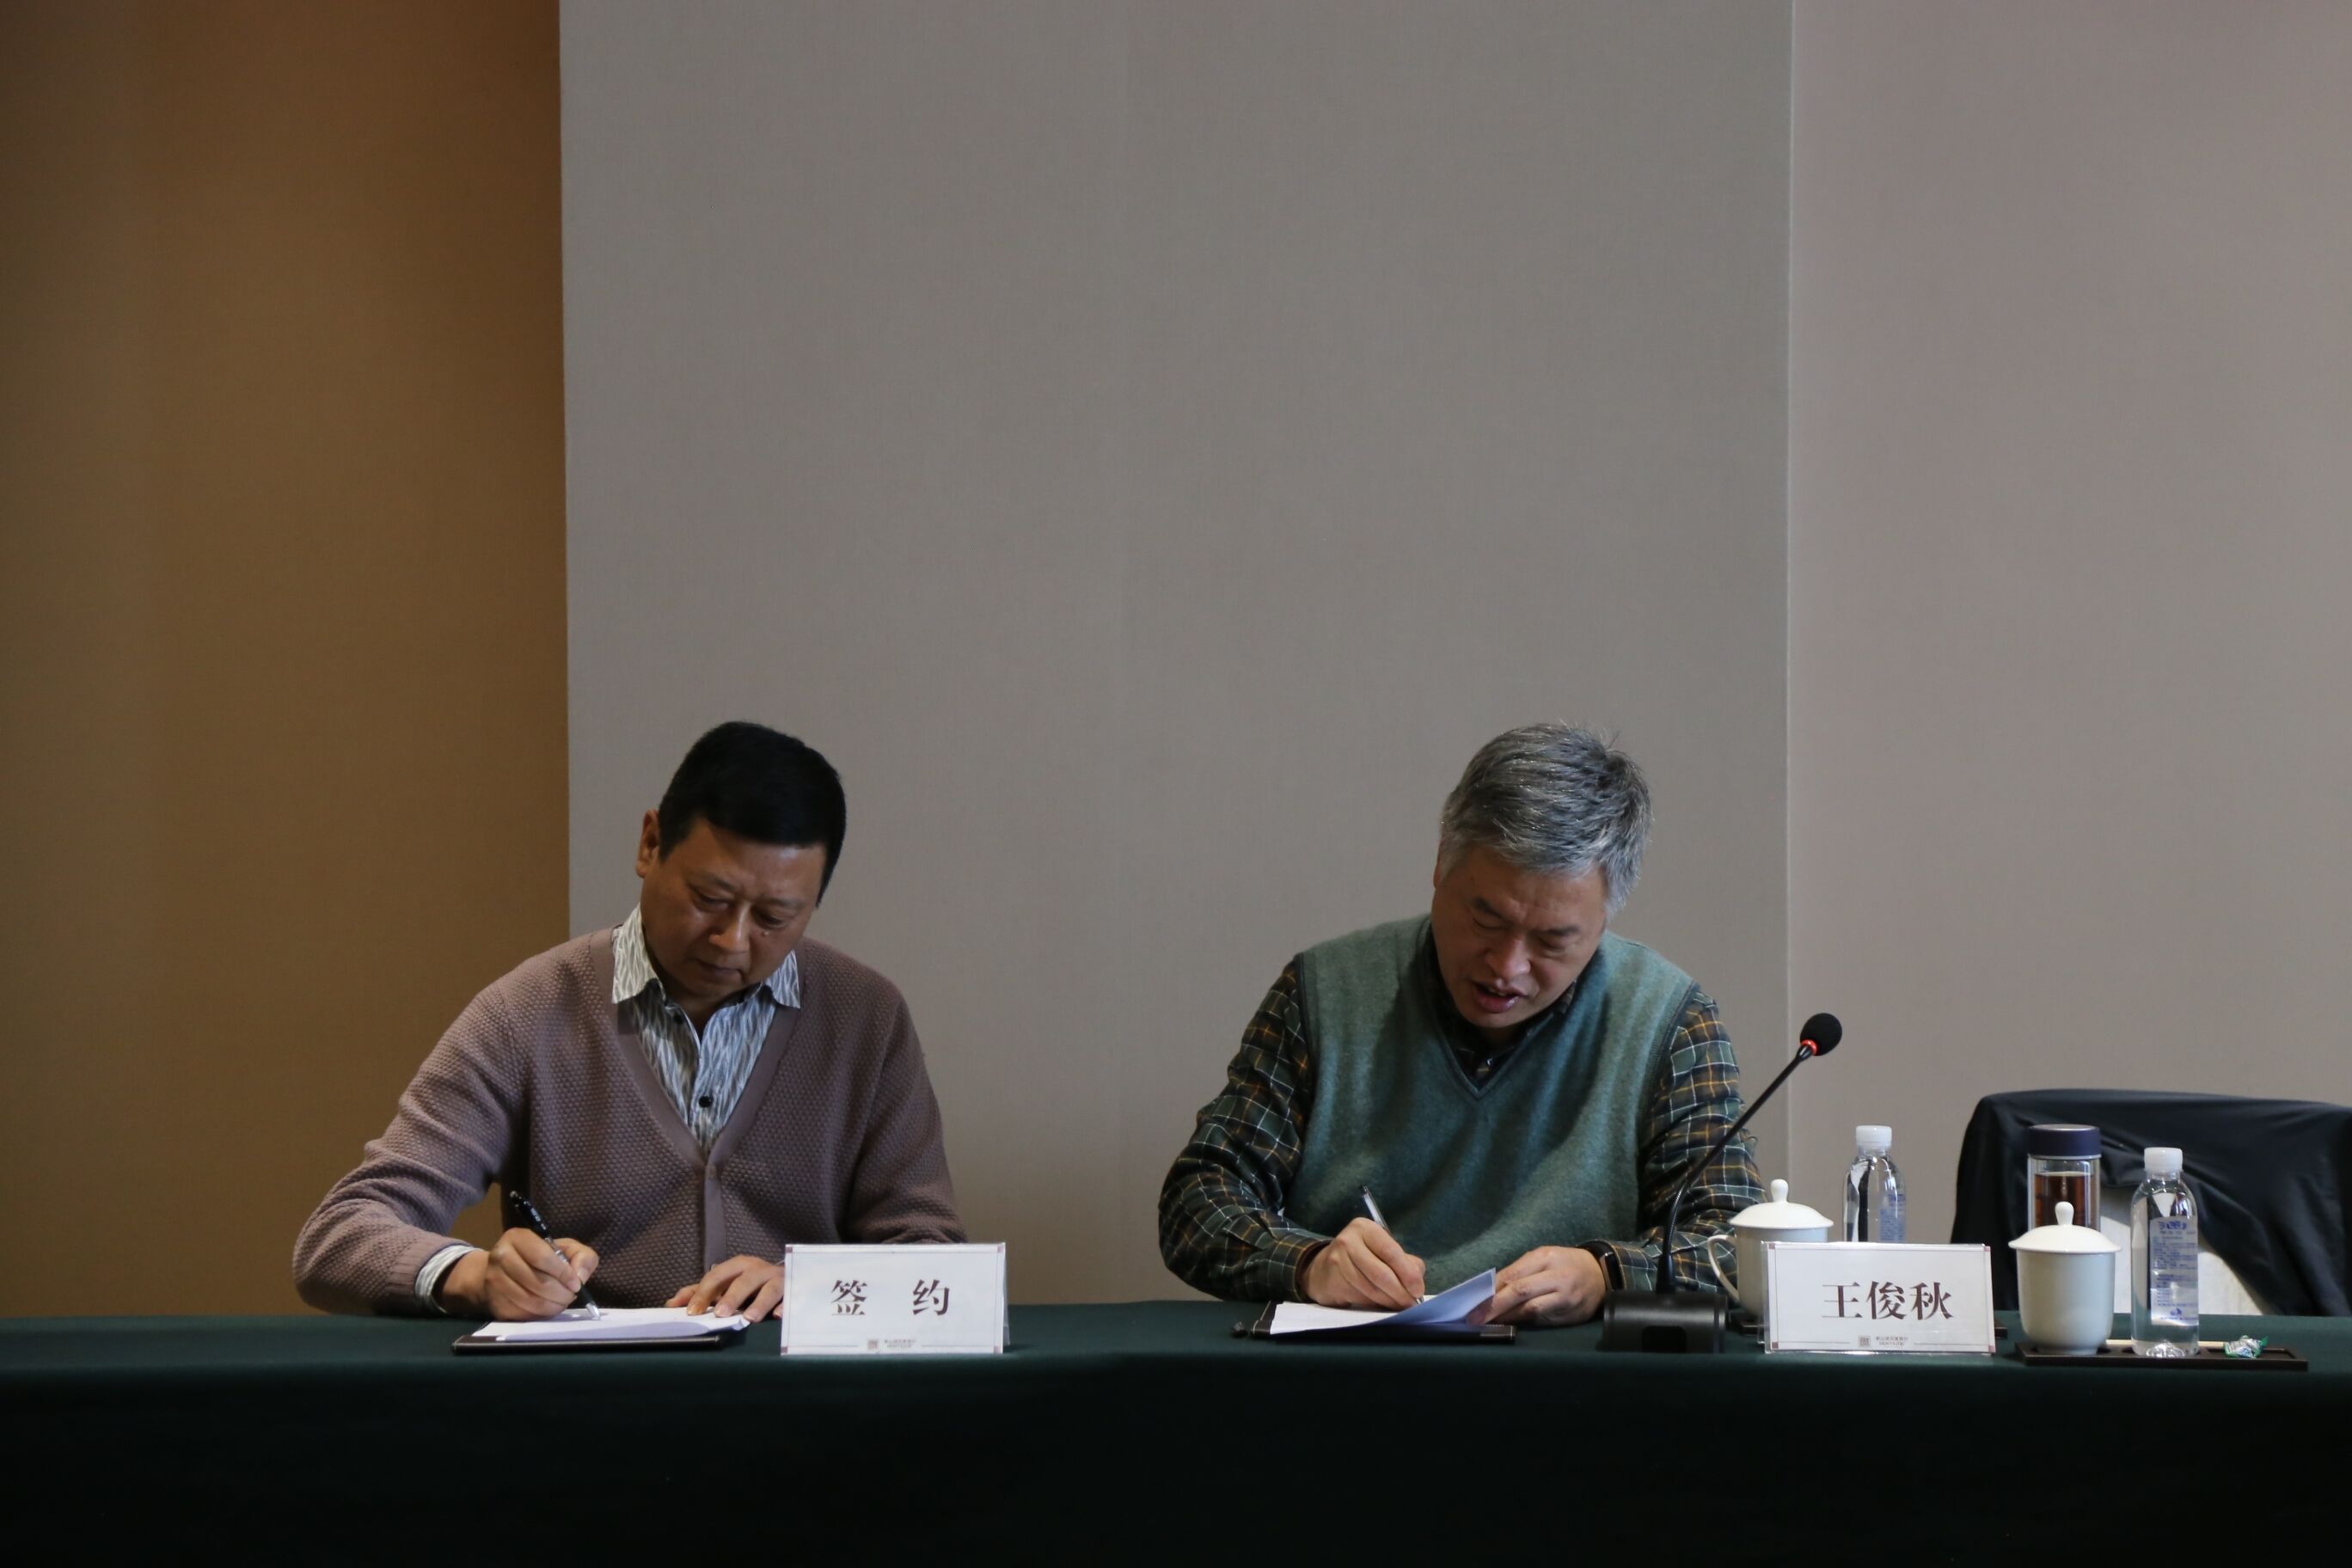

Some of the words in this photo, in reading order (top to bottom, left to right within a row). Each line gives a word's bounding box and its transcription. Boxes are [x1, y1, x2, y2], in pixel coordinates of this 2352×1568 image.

[830, 1279, 950, 1316] 签约
[1822, 1281, 1954, 1320] 王俊秋
